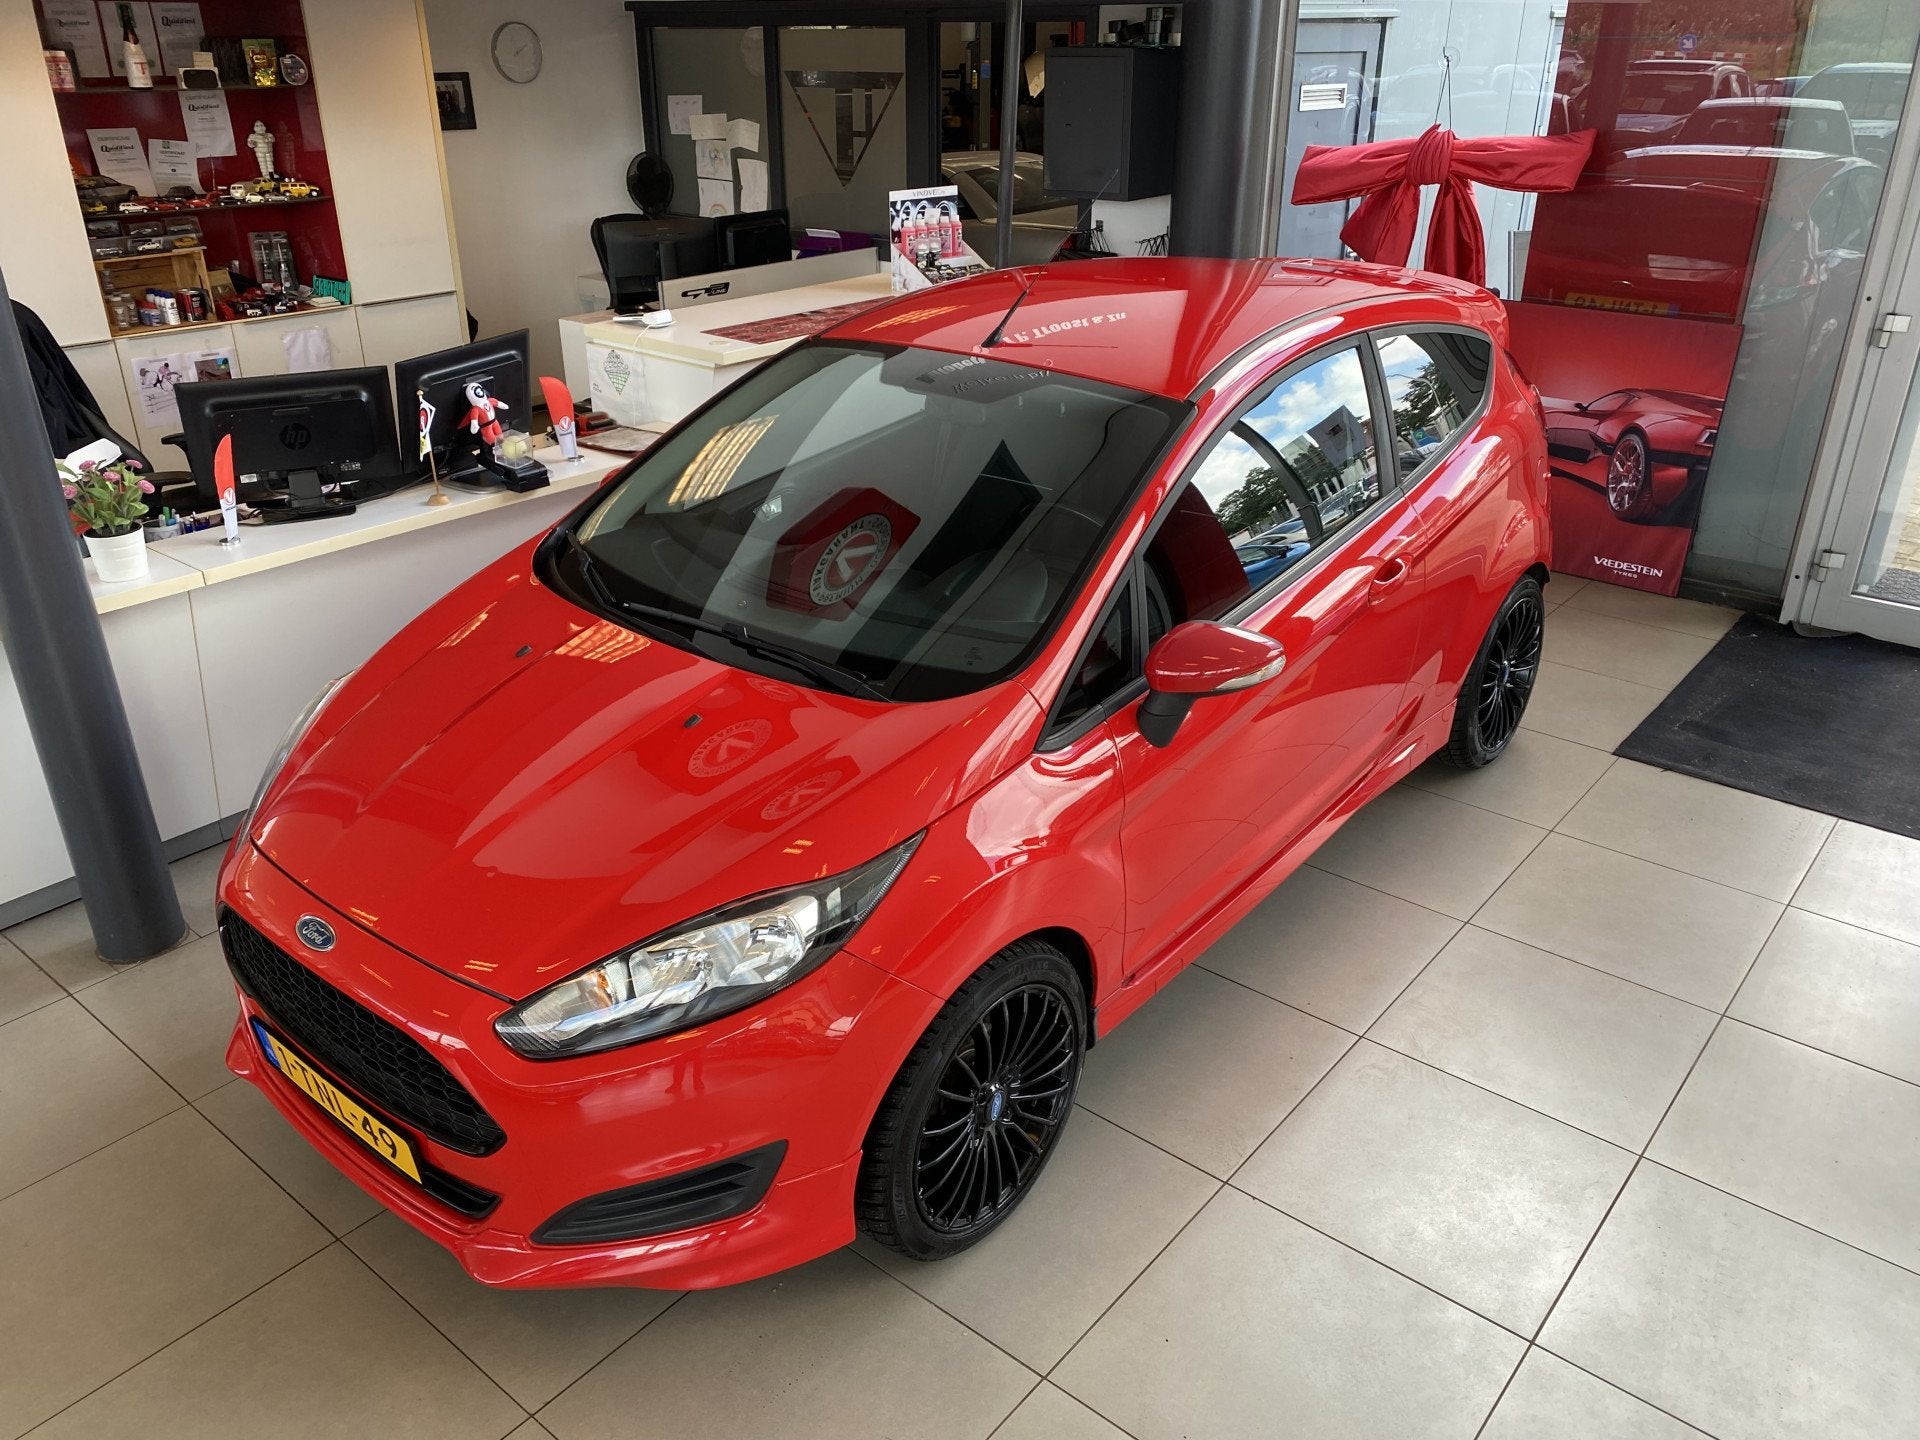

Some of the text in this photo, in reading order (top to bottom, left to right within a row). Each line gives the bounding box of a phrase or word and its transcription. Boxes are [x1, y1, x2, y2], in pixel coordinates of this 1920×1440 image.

[1594, 556, 1663, 577] VREDESTEIN
[1613, 570, 1638, 578] TYRES
[302, 921, 331, 945] Ford
[277, 1046, 398, 1160] 1-TNL-49
